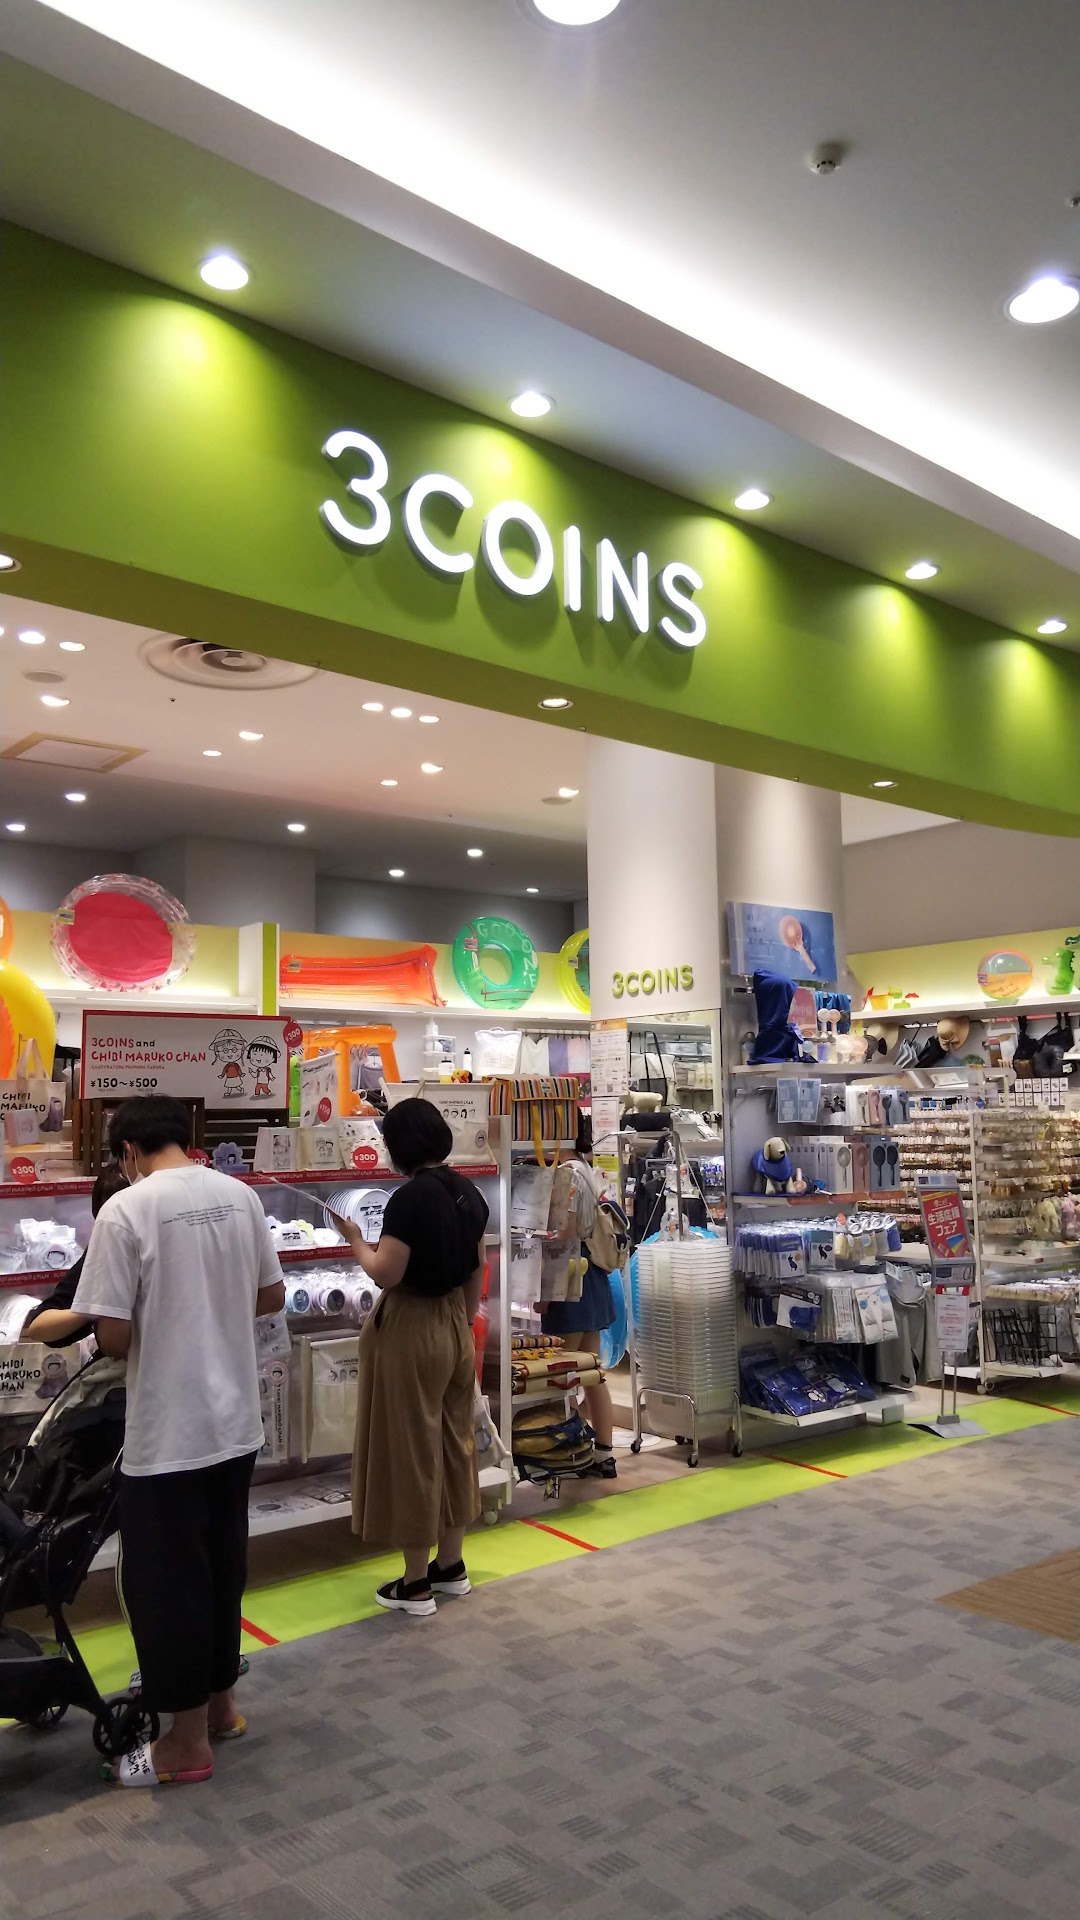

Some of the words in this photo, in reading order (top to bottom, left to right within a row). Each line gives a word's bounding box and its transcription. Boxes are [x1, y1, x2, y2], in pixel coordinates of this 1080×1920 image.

[319, 430, 707, 648] 3COINS
[611, 964, 694, 998] 3COINS
[91, 1037, 134, 1049] 3COINS
[135, 1040, 156, 1048] and
[91, 1050, 122, 1062] CHIBI
[125, 1051, 173, 1062] MARUKO
[175, 1051, 206, 1063] CHAN
[354, 1153, 376, 1161] ¥300
[936, 1220, 957, 1237] フェア
[0, 1358, 24, 1369] HIBI
[0, 1381, 25, 1392] HAN
